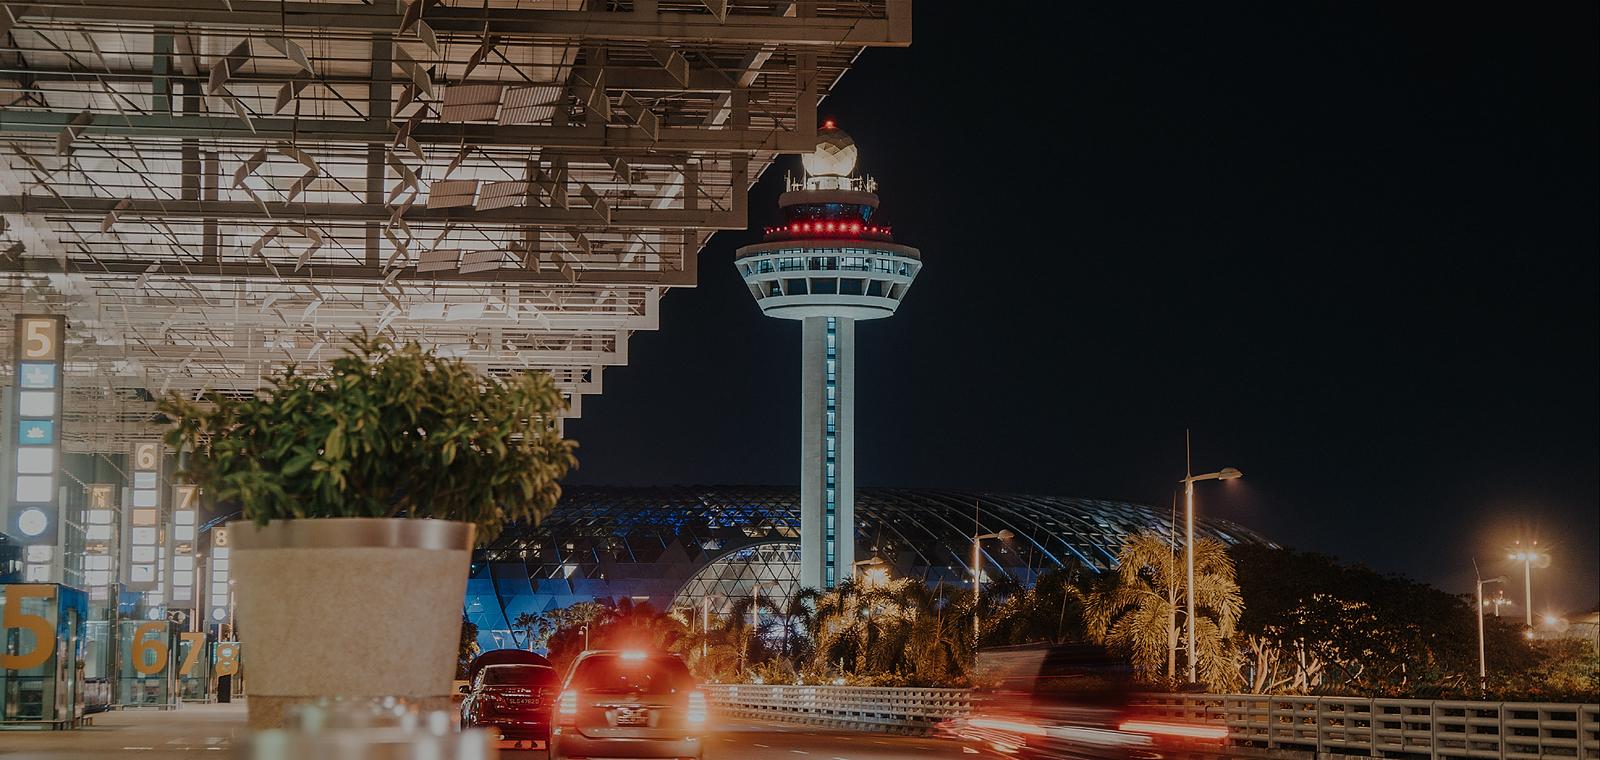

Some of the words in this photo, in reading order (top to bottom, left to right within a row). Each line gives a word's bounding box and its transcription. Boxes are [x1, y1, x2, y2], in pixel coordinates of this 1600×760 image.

[27, 321, 50, 357] 5
[137, 444, 156, 468] 6
[179, 488, 197, 508] 7
[215, 529, 228, 546] 8
[0, 585, 57, 670] 5
[131, 621, 168, 675] 6
[180, 632, 205, 675] 7
[215, 643, 239, 677] 8
